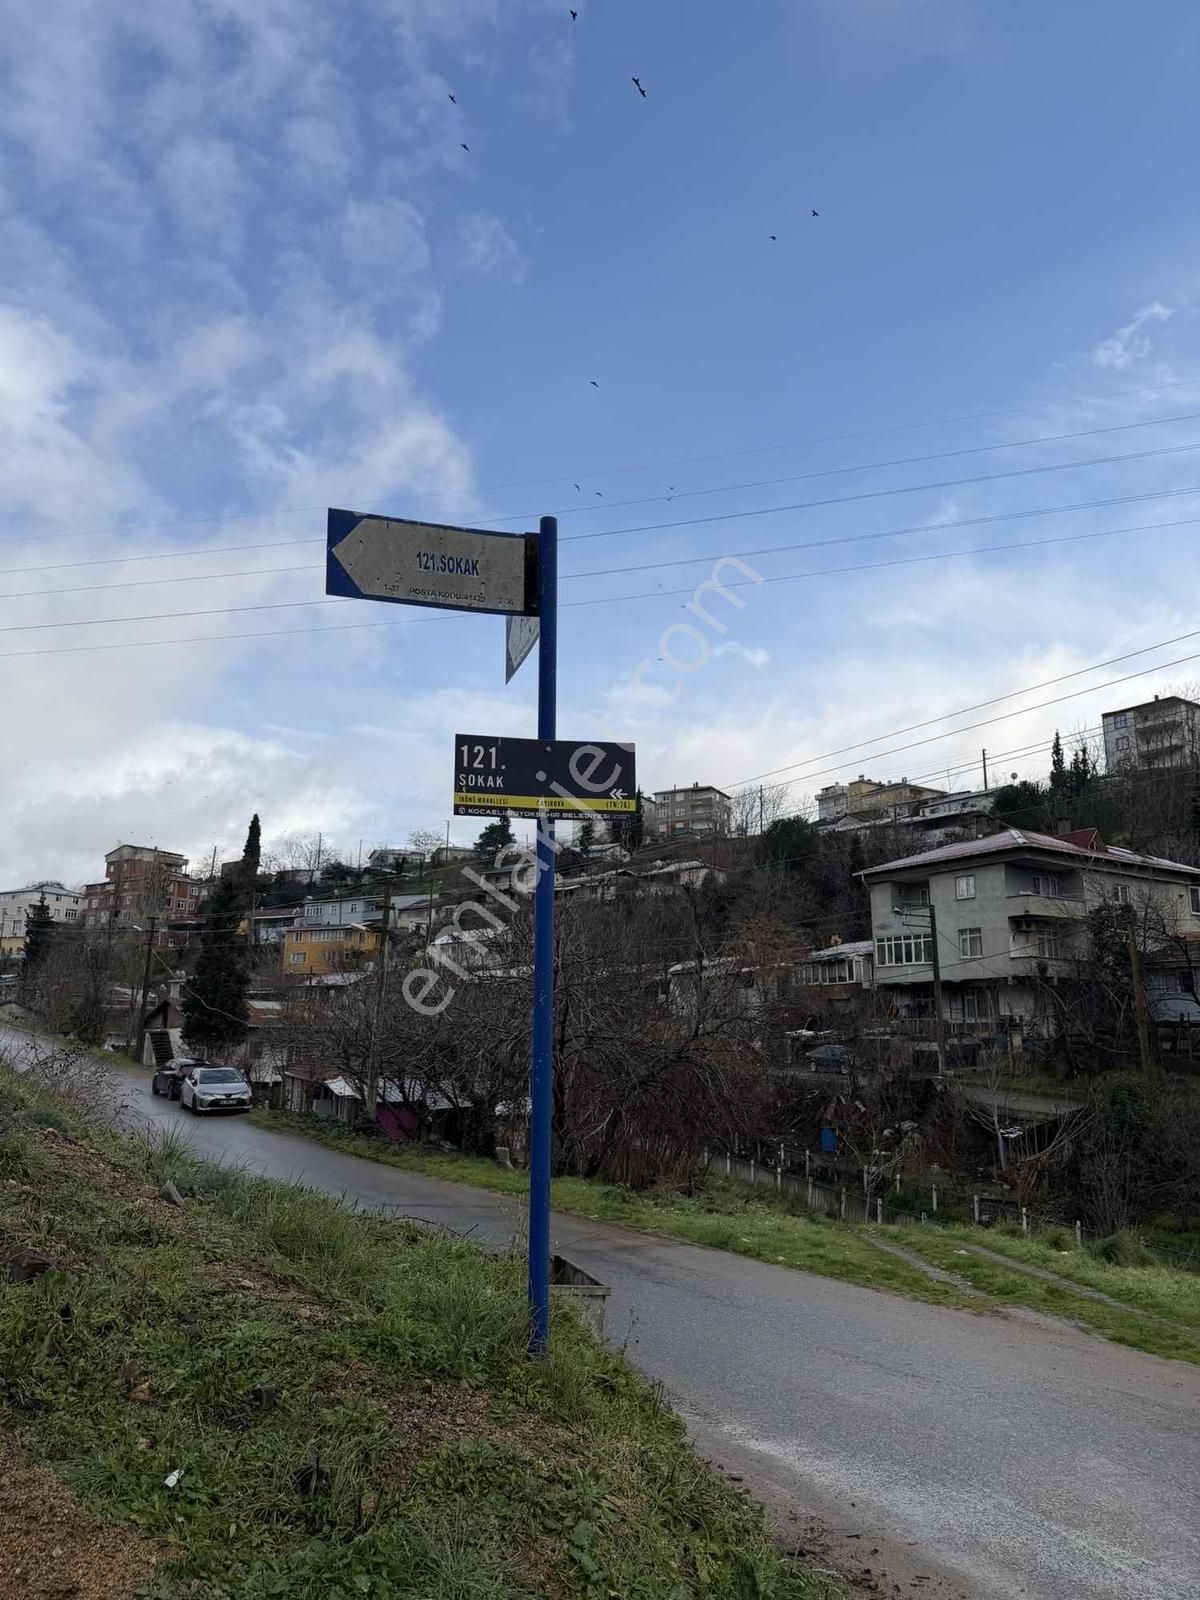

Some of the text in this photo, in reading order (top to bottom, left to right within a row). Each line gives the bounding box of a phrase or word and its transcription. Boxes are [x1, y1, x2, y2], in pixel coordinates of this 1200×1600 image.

[409, 587, 436, 597] POSTA
[460, 744, 506, 770] 121.
[459, 773, 504, 788] SOKAK
